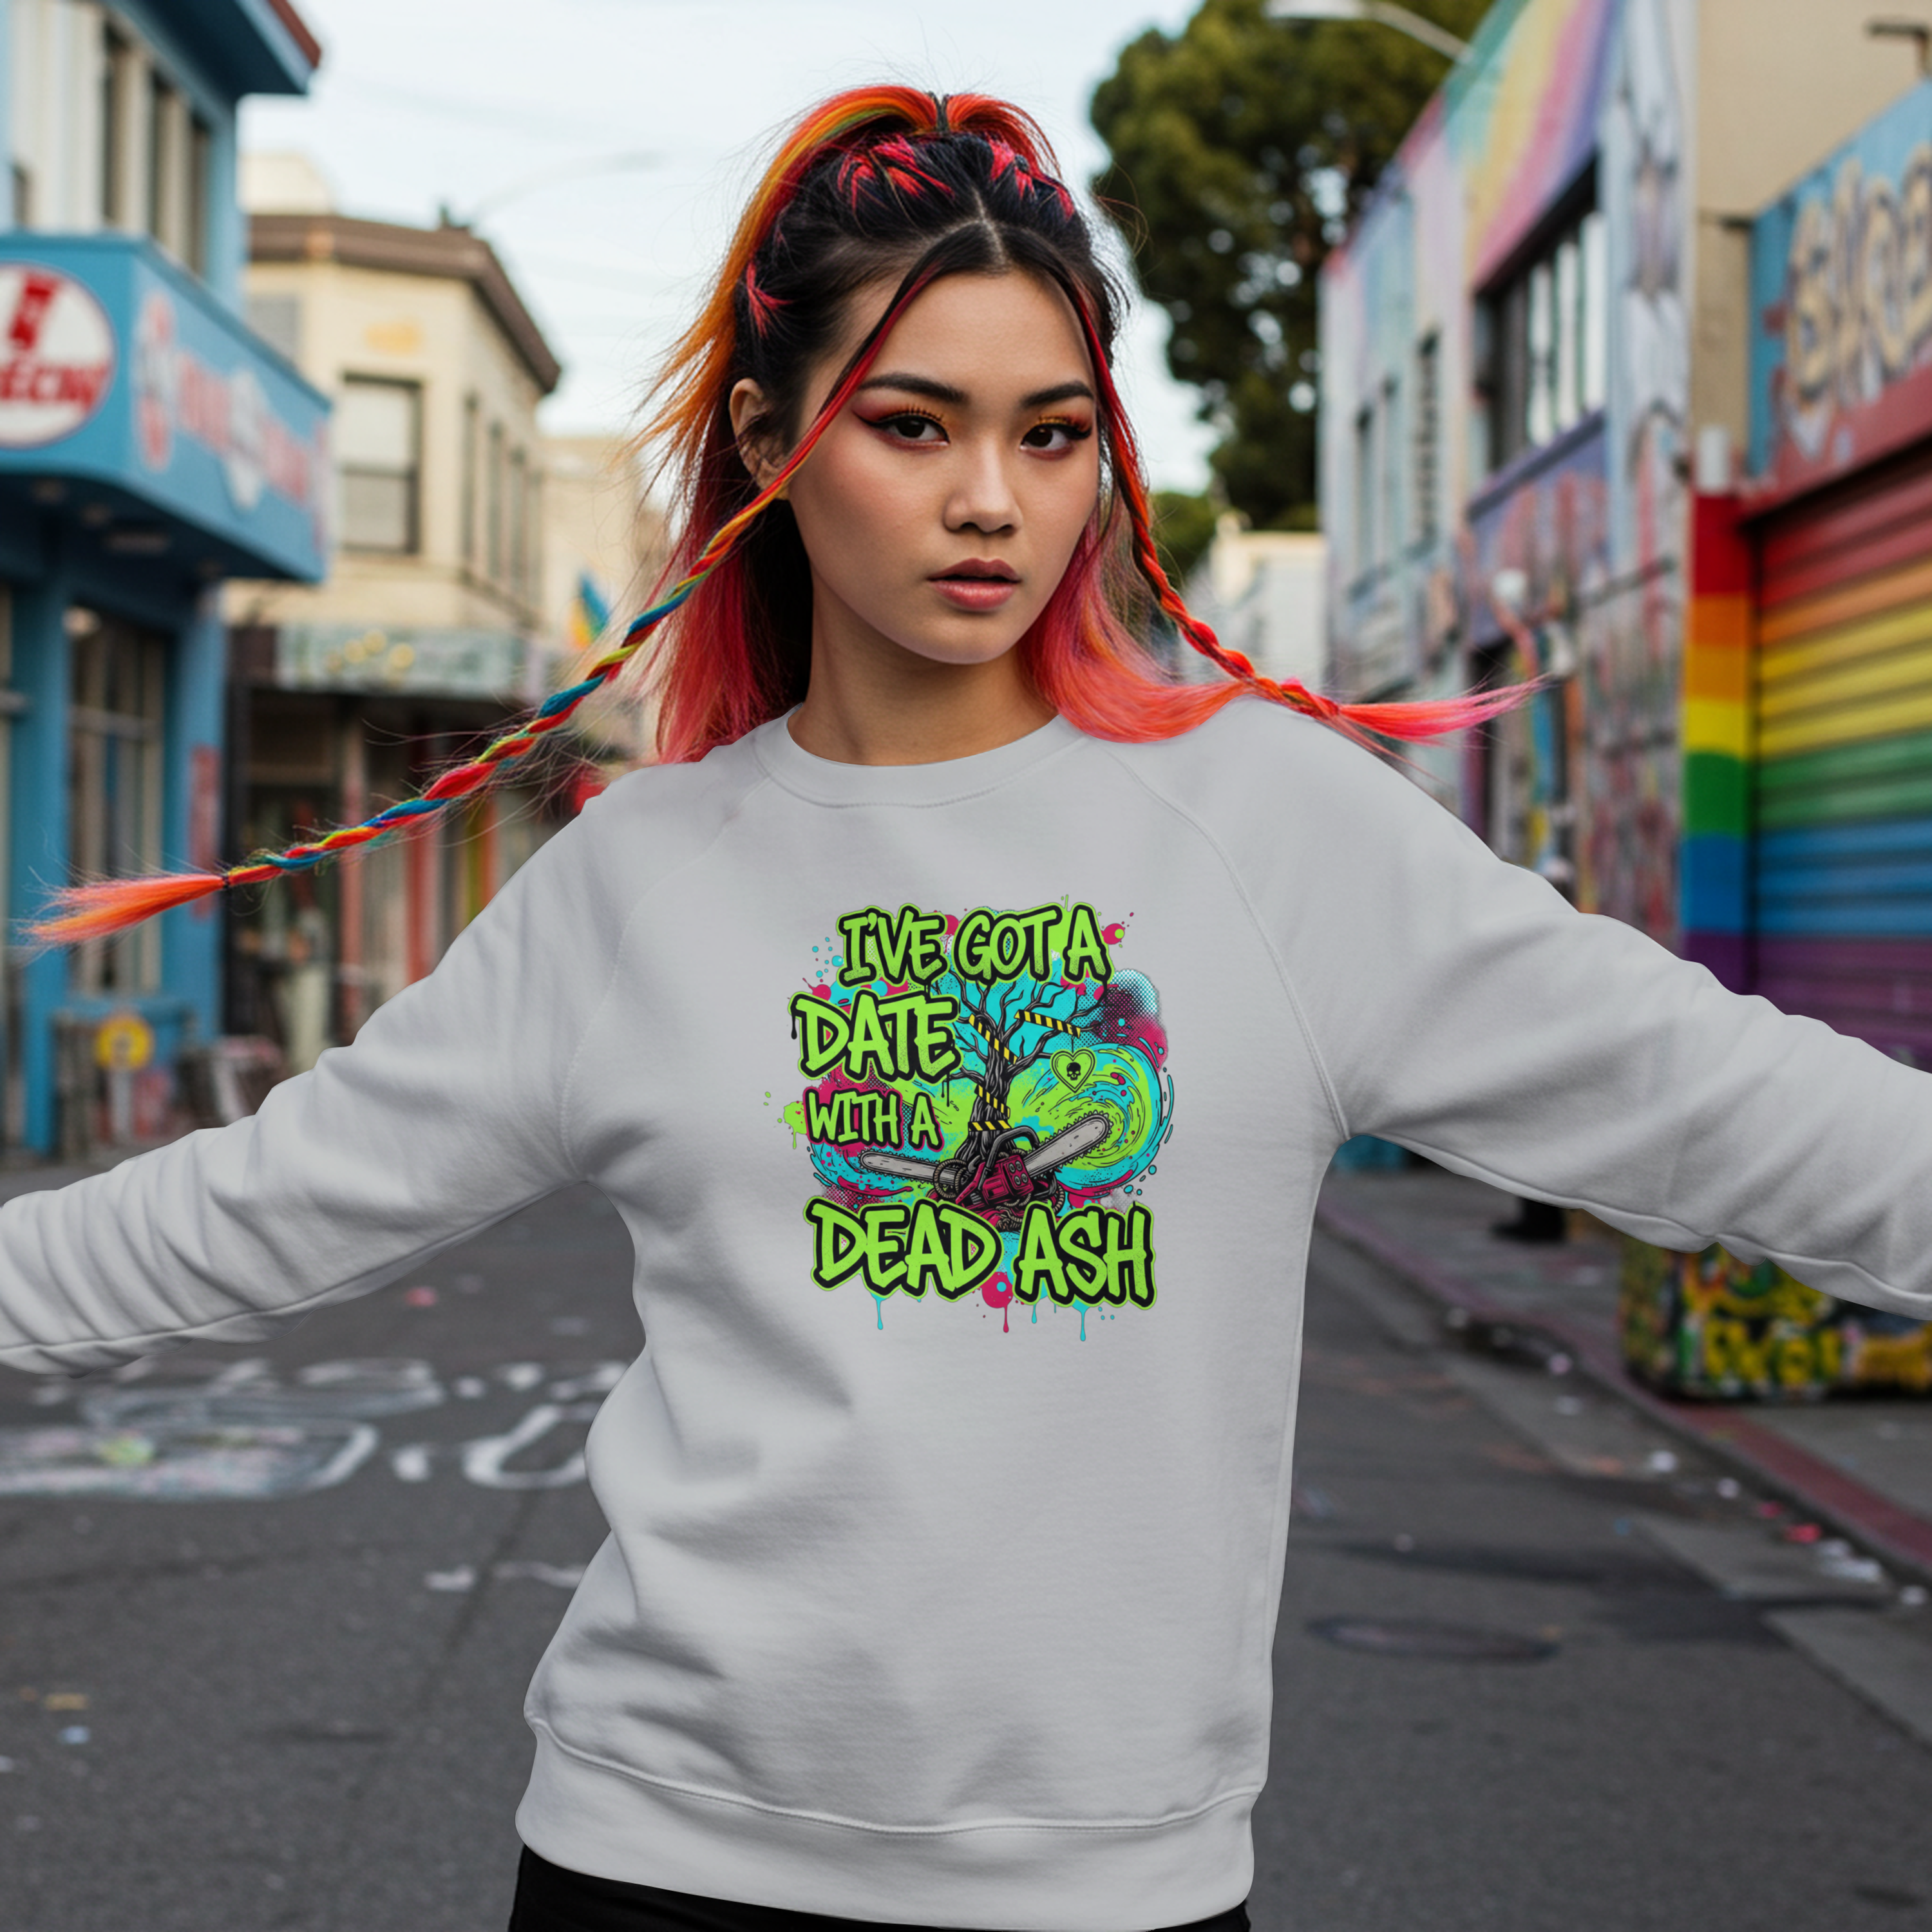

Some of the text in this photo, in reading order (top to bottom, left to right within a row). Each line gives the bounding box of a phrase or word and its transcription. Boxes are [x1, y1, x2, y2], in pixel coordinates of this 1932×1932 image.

[839, 905, 1112, 985] I'VE GOT A
[792, 993, 960, 1082] DATE
[806, 1090, 942, 1149] WITH A
[806, 1198, 1155, 1308] DEAD ASH
